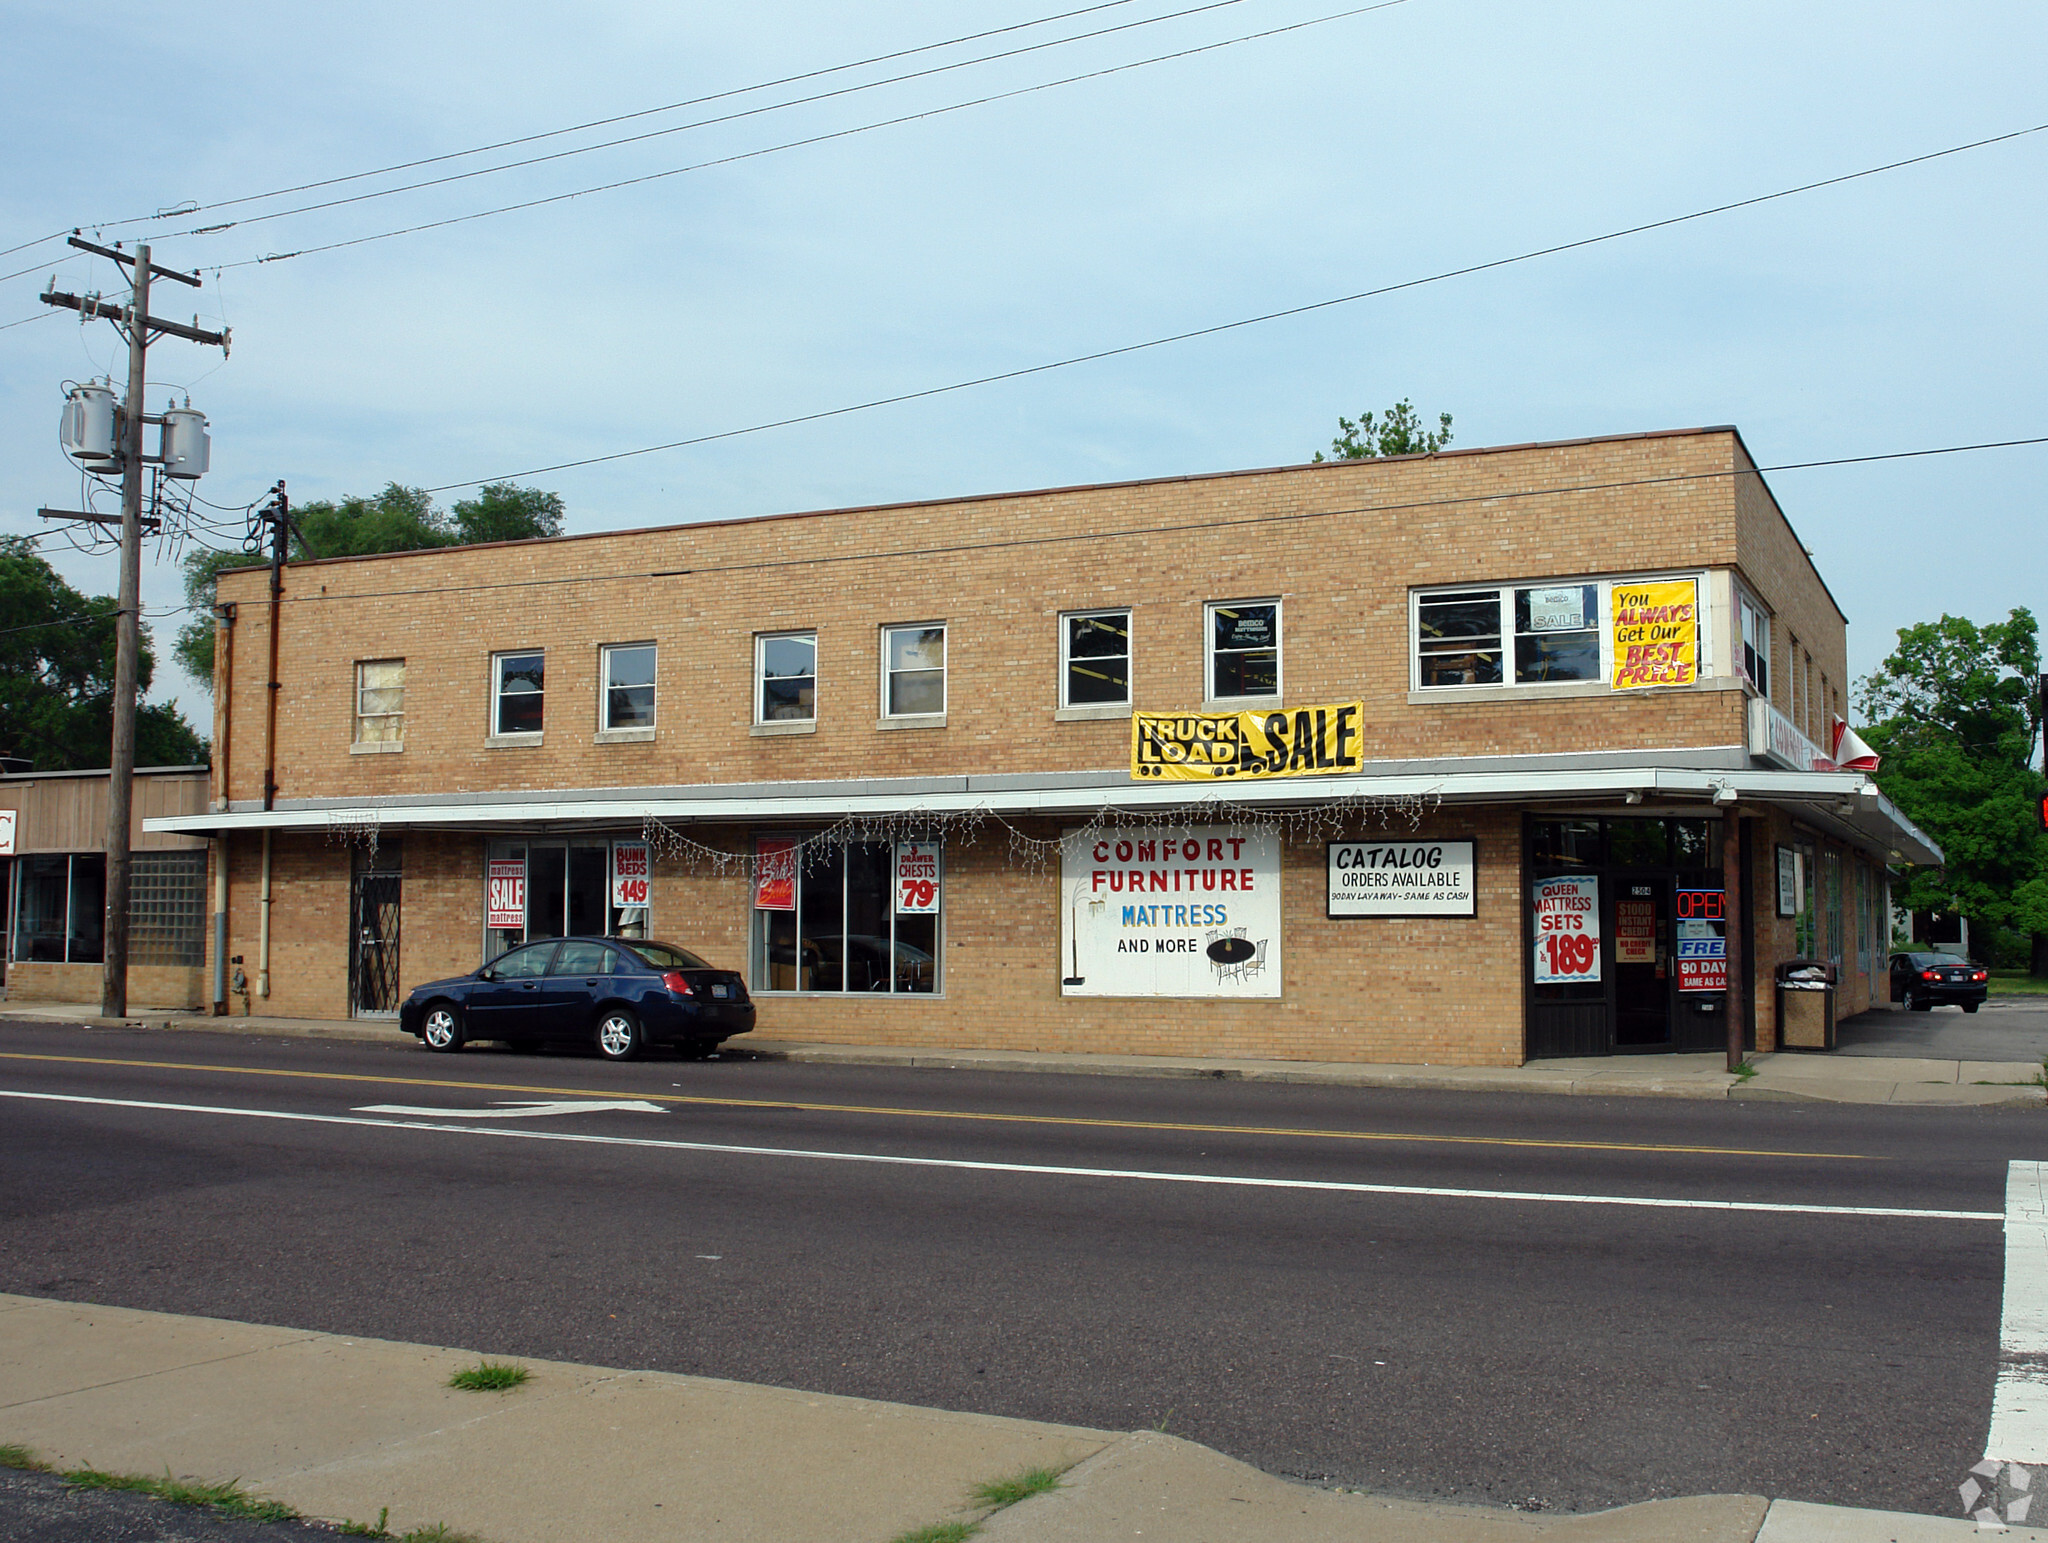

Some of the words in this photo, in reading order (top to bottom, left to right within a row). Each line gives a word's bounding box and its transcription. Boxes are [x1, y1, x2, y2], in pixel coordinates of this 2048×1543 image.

[1619, 593, 1649, 608] You
[1533, 613, 1582, 629] SALE
[1615, 603, 1693, 627] ALWAYS
[1618, 627, 1645, 643] Get
[1651, 625, 1681, 641] Our
[1626, 642, 1685, 668] BEST
[1616, 663, 1692, 686] PRICE
[1140, 719, 1238, 742] TRUCK
[1264, 706, 1356, 773] SALE
[1142, 742, 1235, 763] LOAD
[616, 847, 647, 863] BUNK
[1093, 838, 1246, 863] COMFORT
[1336, 847, 1442, 869] CATALOG
[490, 866, 523, 875] mattress
[617, 862, 647, 876] BEDS
[899, 864, 936, 877] CHESTS
[1092, 869, 1254, 892] FURNITURE
[1342, 872, 1388, 887] ORDERS
[1391, 872, 1461, 887] AVAILABLE
[490, 878, 523, 910] SALE
[1403, 892, 1430, 900] SAME
[1433, 892, 1444, 900] AS
[1446, 892, 1469, 900] CASH
[1542, 884, 1578, 897] QUEEN
[1533, 897, 1591, 913] MATTRESS
[1619, 903, 1652, 916] $1000
[490, 913, 523, 923] mattress
[1122, 904, 1228, 927] MATTRESS
[1541, 914, 1583, 930] SETS
[1619, 916, 1652, 926] INSTANT
[1621, 927, 1650, 937] CREDIT
[1117, 939, 1149, 953] AND
[1155, 938, 1198, 953] MORE
[1680, 942, 1726, 955] FRE
[1681, 962, 1697, 975] 90
[1684, 977, 1703, 987] SAME
[1704, 977, 1714, 986] AS
[1715, 977, 1727, 986] CA
